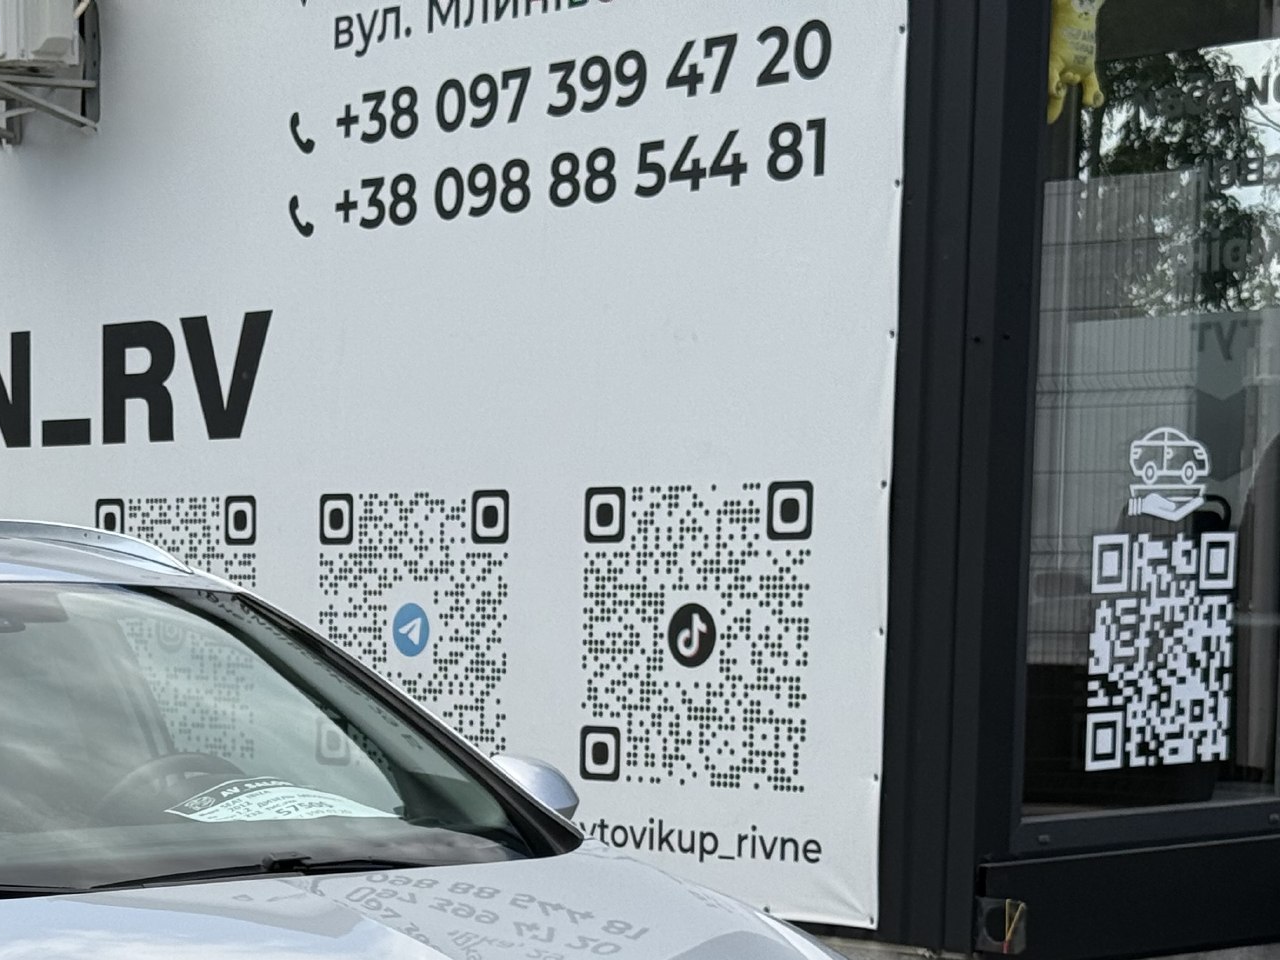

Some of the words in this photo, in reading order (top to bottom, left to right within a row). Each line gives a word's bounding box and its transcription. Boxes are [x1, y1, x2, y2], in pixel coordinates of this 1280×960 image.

[333, 5, 412, 58] вул.
[336, 85, 419, 145] +38
[435, 66, 531, 133] 097
[546, 49, 648, 118] 399
[666, 33, 739, 98] 47
[756, 19, 833, 88] 20
[335, 172, 418, 230] +38
[434, 158, 531, 220] 098
[548, 147, 618, 208] 88
[634, 129, 749, 199] 544
[766, 117, 827, 181] 81
[575, 817, 822, 863] vtovikup_rivne
